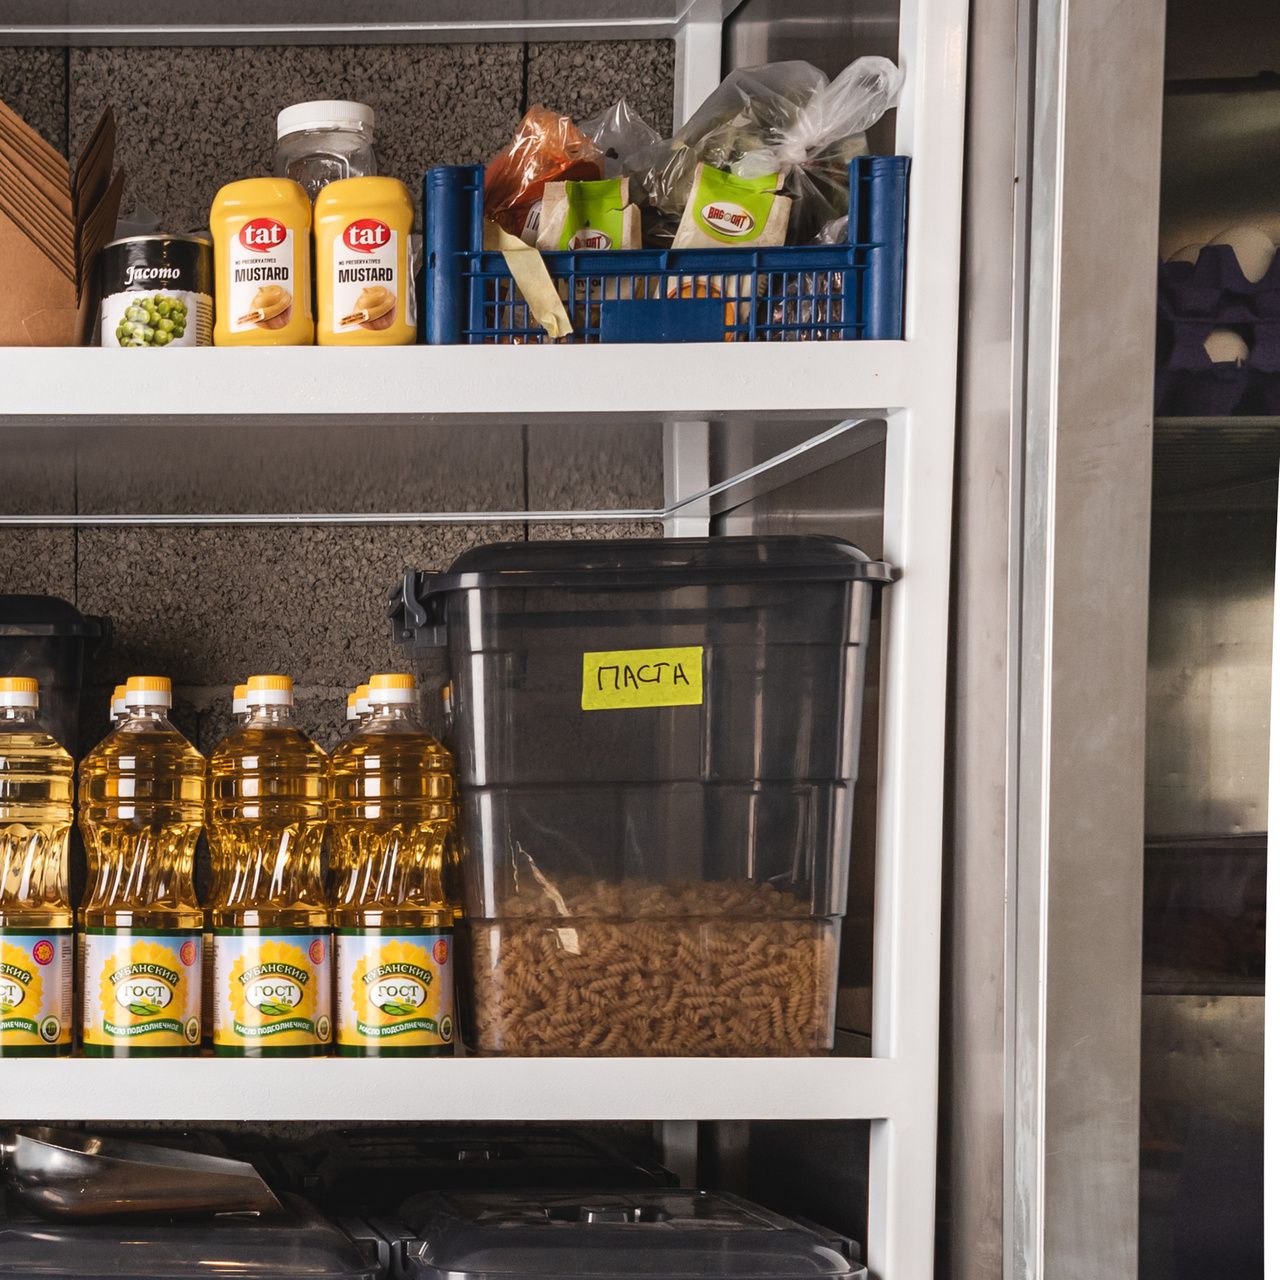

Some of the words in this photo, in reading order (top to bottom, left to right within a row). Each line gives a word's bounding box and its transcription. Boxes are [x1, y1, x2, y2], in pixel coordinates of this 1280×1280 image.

[245, 224, 282, 245] tat
[349, 225, 385, 245] tat
[124, 266, 180, 285] Jacomo
[235, 267, 288, 282] MUSTARD
[338, 267, 393, 283] MUSTARD
[598, 663, 689, 690] ПАСТА
[111, 964, 178, 984] КУБАНСКИЙ
[240, 963, 307, 984] КУБАНСКИЙ
[364, 963, 432, 984] КУБАНСКИЙ
[124, 985, 165, 997] ГОСТ
[254, 985, 295, 997] ГОСТ
[378, 985, 419, 997] ГОСТ
[105, 1024, 125, 1035] МАСЛО
[127, 1022, 179, 1034] ПОДСОЛНЕЧНОЕ
[235, 1024, 257, 1035] МАСЛО
[258, 1021, 310, 1034] ПОДСОЛНЕЧНОЕ
[359, 1024, 380, 1035] МАСЛО
[381, 1022, 434, 1035] ПОДСОЛНЕЧНОЕ
